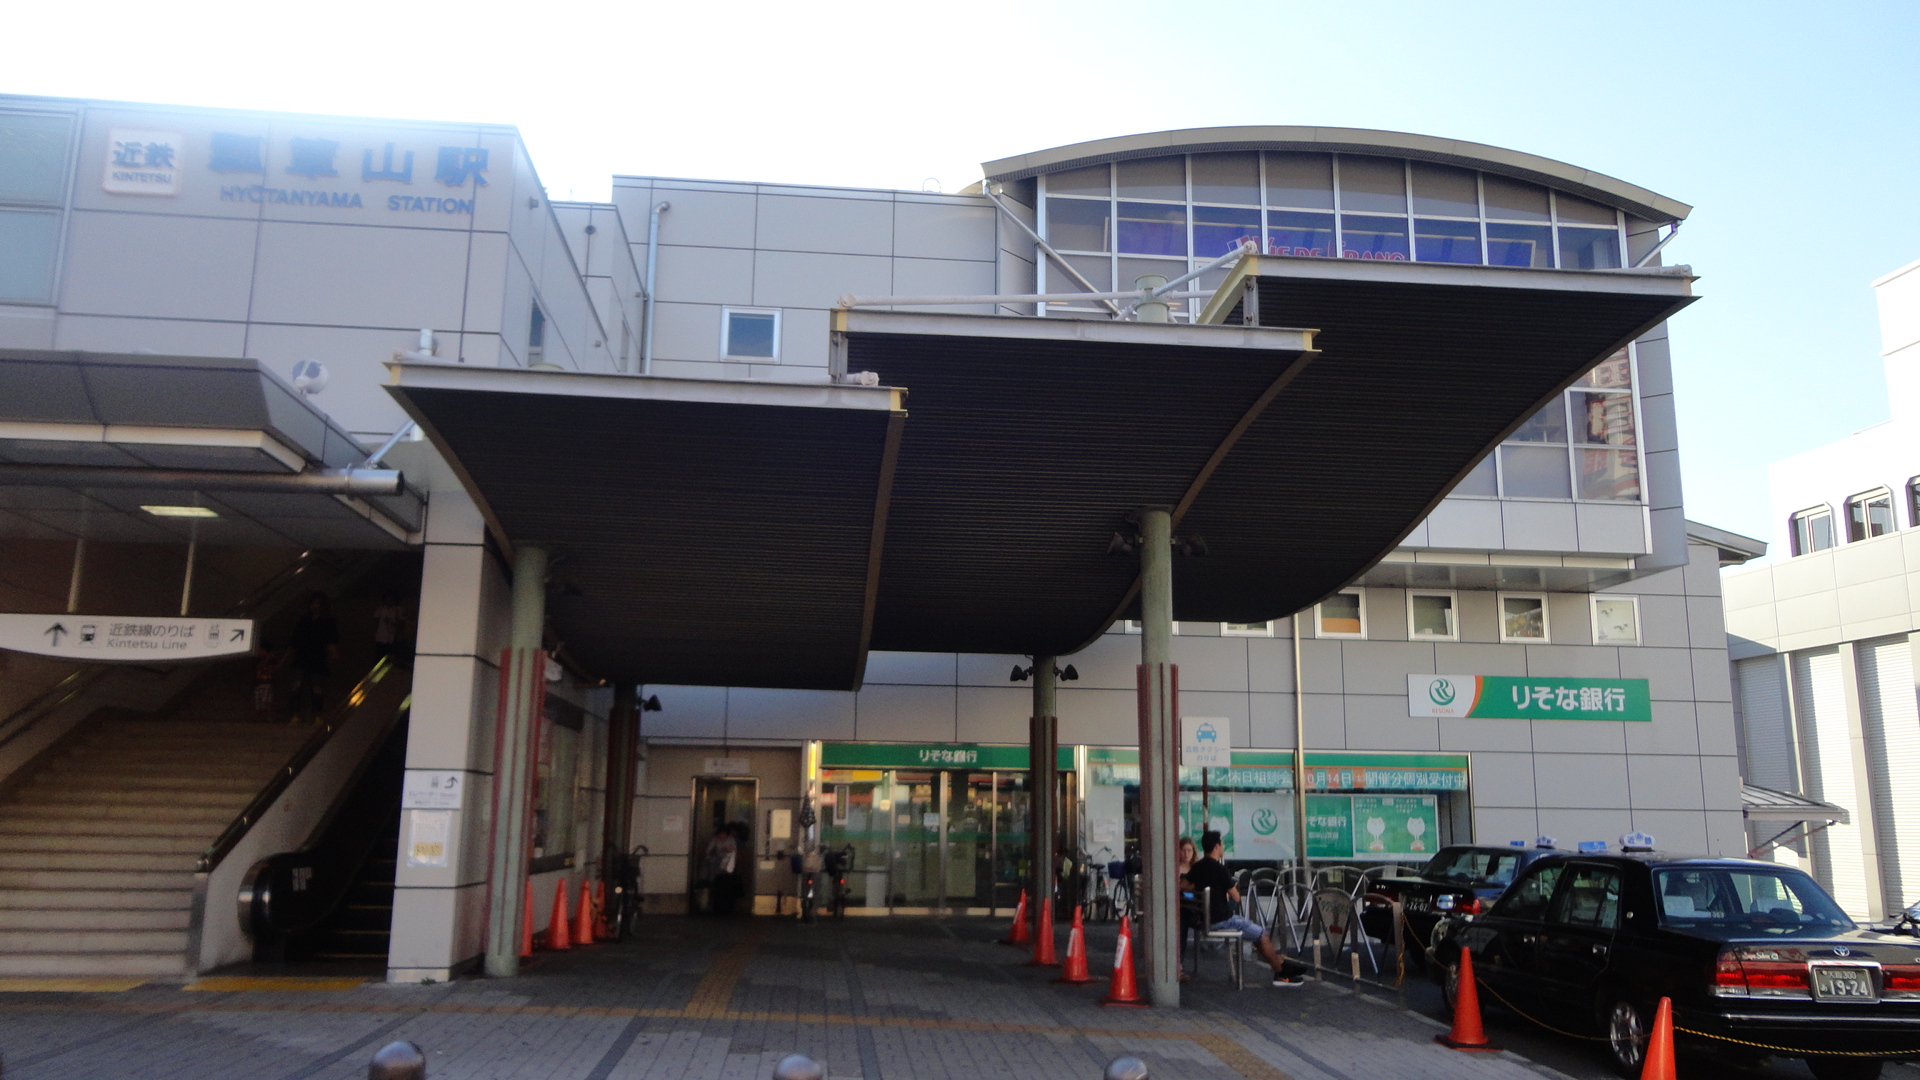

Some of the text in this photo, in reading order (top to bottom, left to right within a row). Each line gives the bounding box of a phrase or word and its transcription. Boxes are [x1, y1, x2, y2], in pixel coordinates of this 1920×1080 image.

[111, 140, 175, 168] 近鉄
[206, 131, 490, 187] 山駅
[111, 171, 172, 184] KINTETSU
[220, 184, 474, 215] HYOTANYAMA STATION
[108, 622, 196, 637] 近鉄線のりば
[106, 637, 188, 651] Kintetsu Line
[1511, 685, 1627, 712] りそな銀行
[919, 749, 978, 763] りそな銀行
[1306, 815, 1347, 828] そな銀行
[1829, 980, 1869, 995] 19-24
